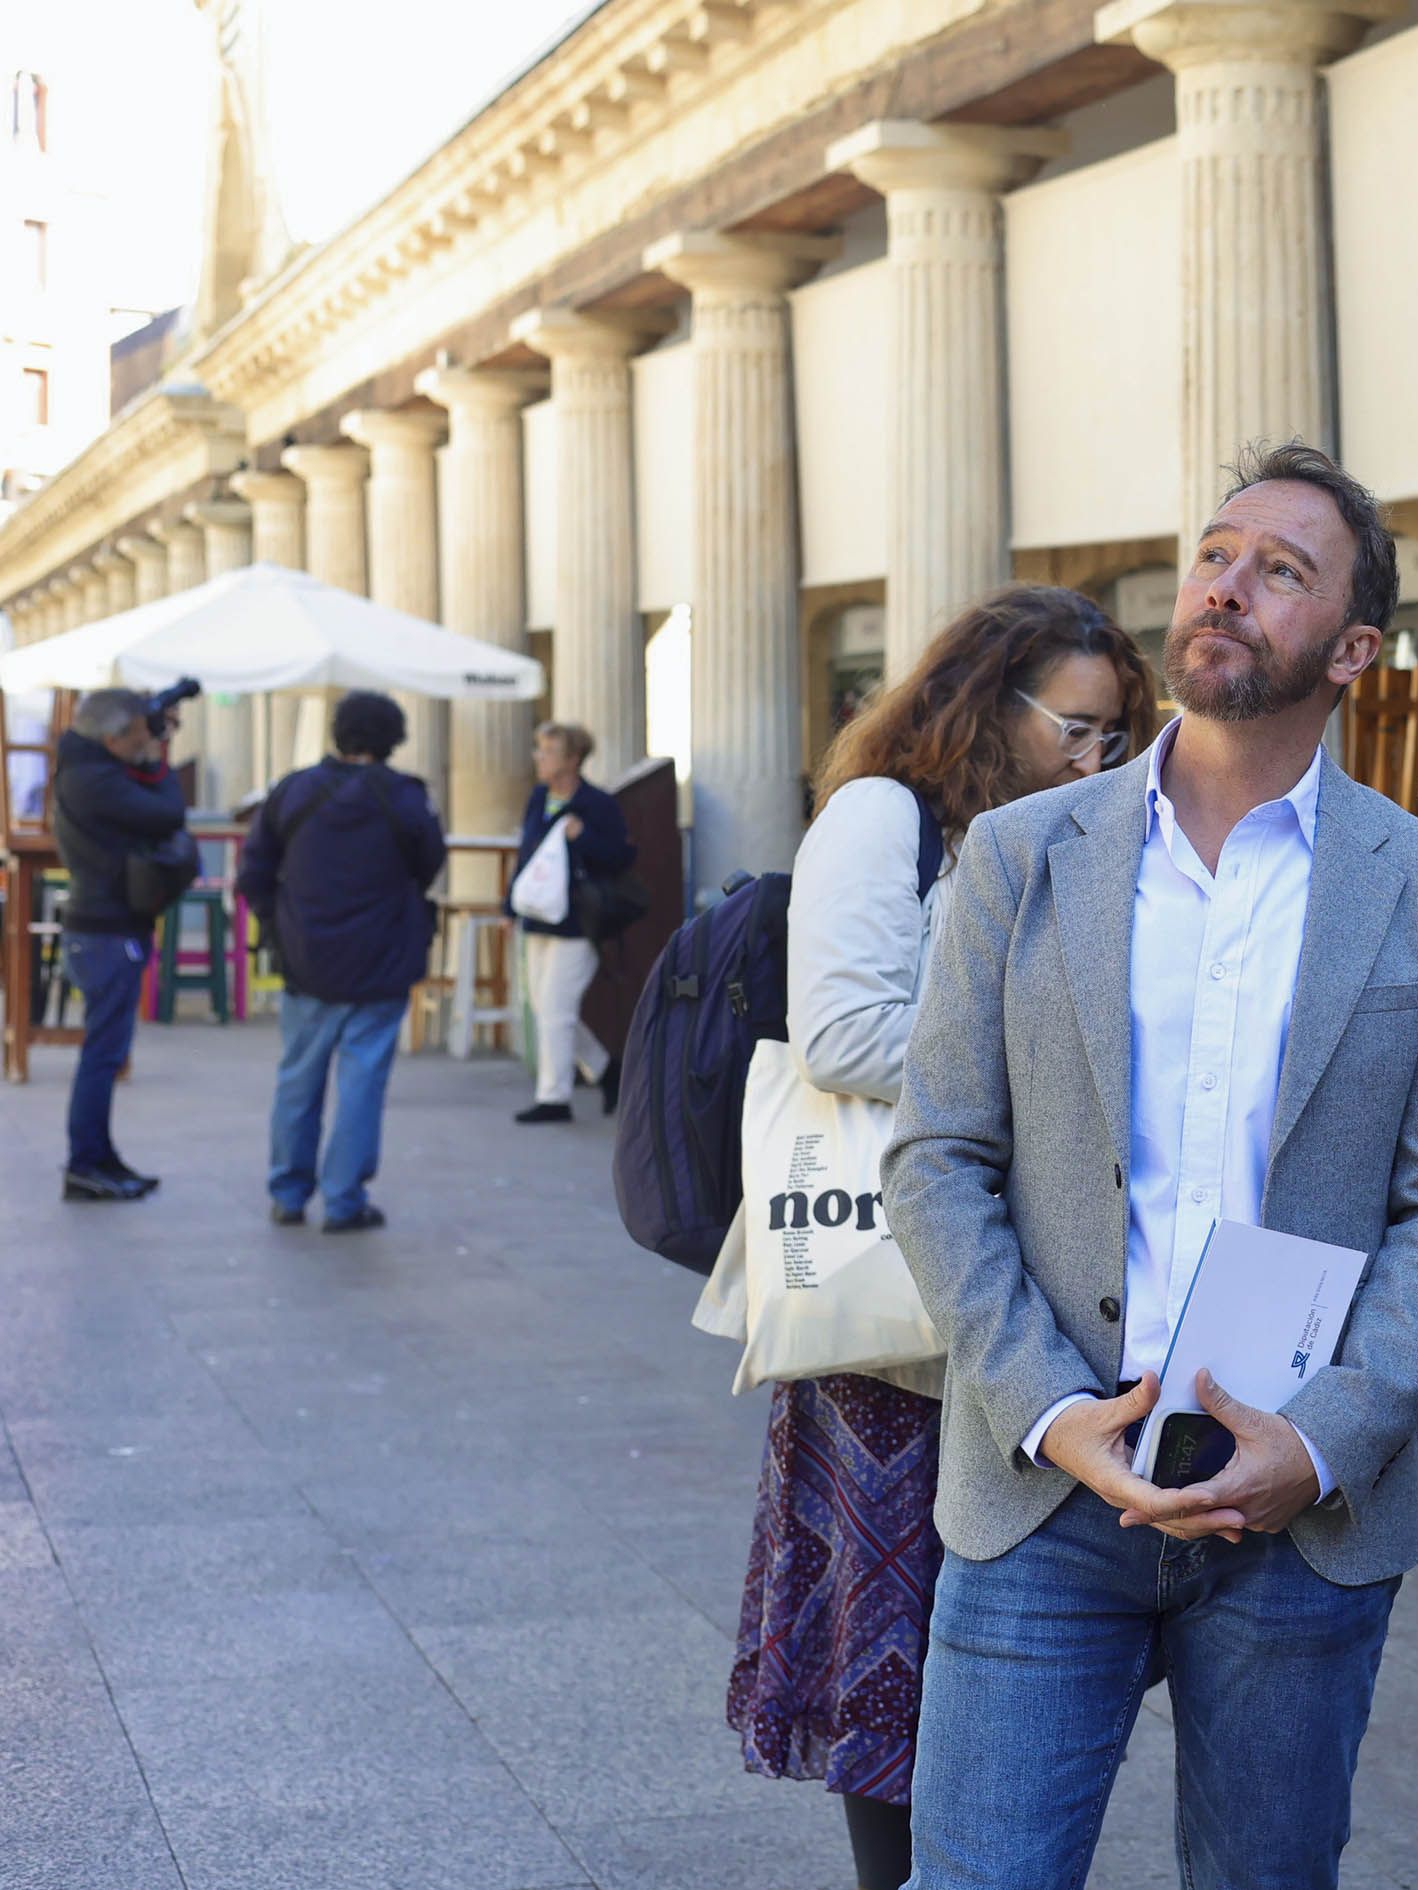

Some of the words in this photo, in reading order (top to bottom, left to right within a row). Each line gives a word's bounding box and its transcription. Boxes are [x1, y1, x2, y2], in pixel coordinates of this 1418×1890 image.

[1297, 1308, 1316, 1349] Diputación
[1310, 1317, 1322, 1339] Cádiz
[1307, 1338, 1315, 1350] de
